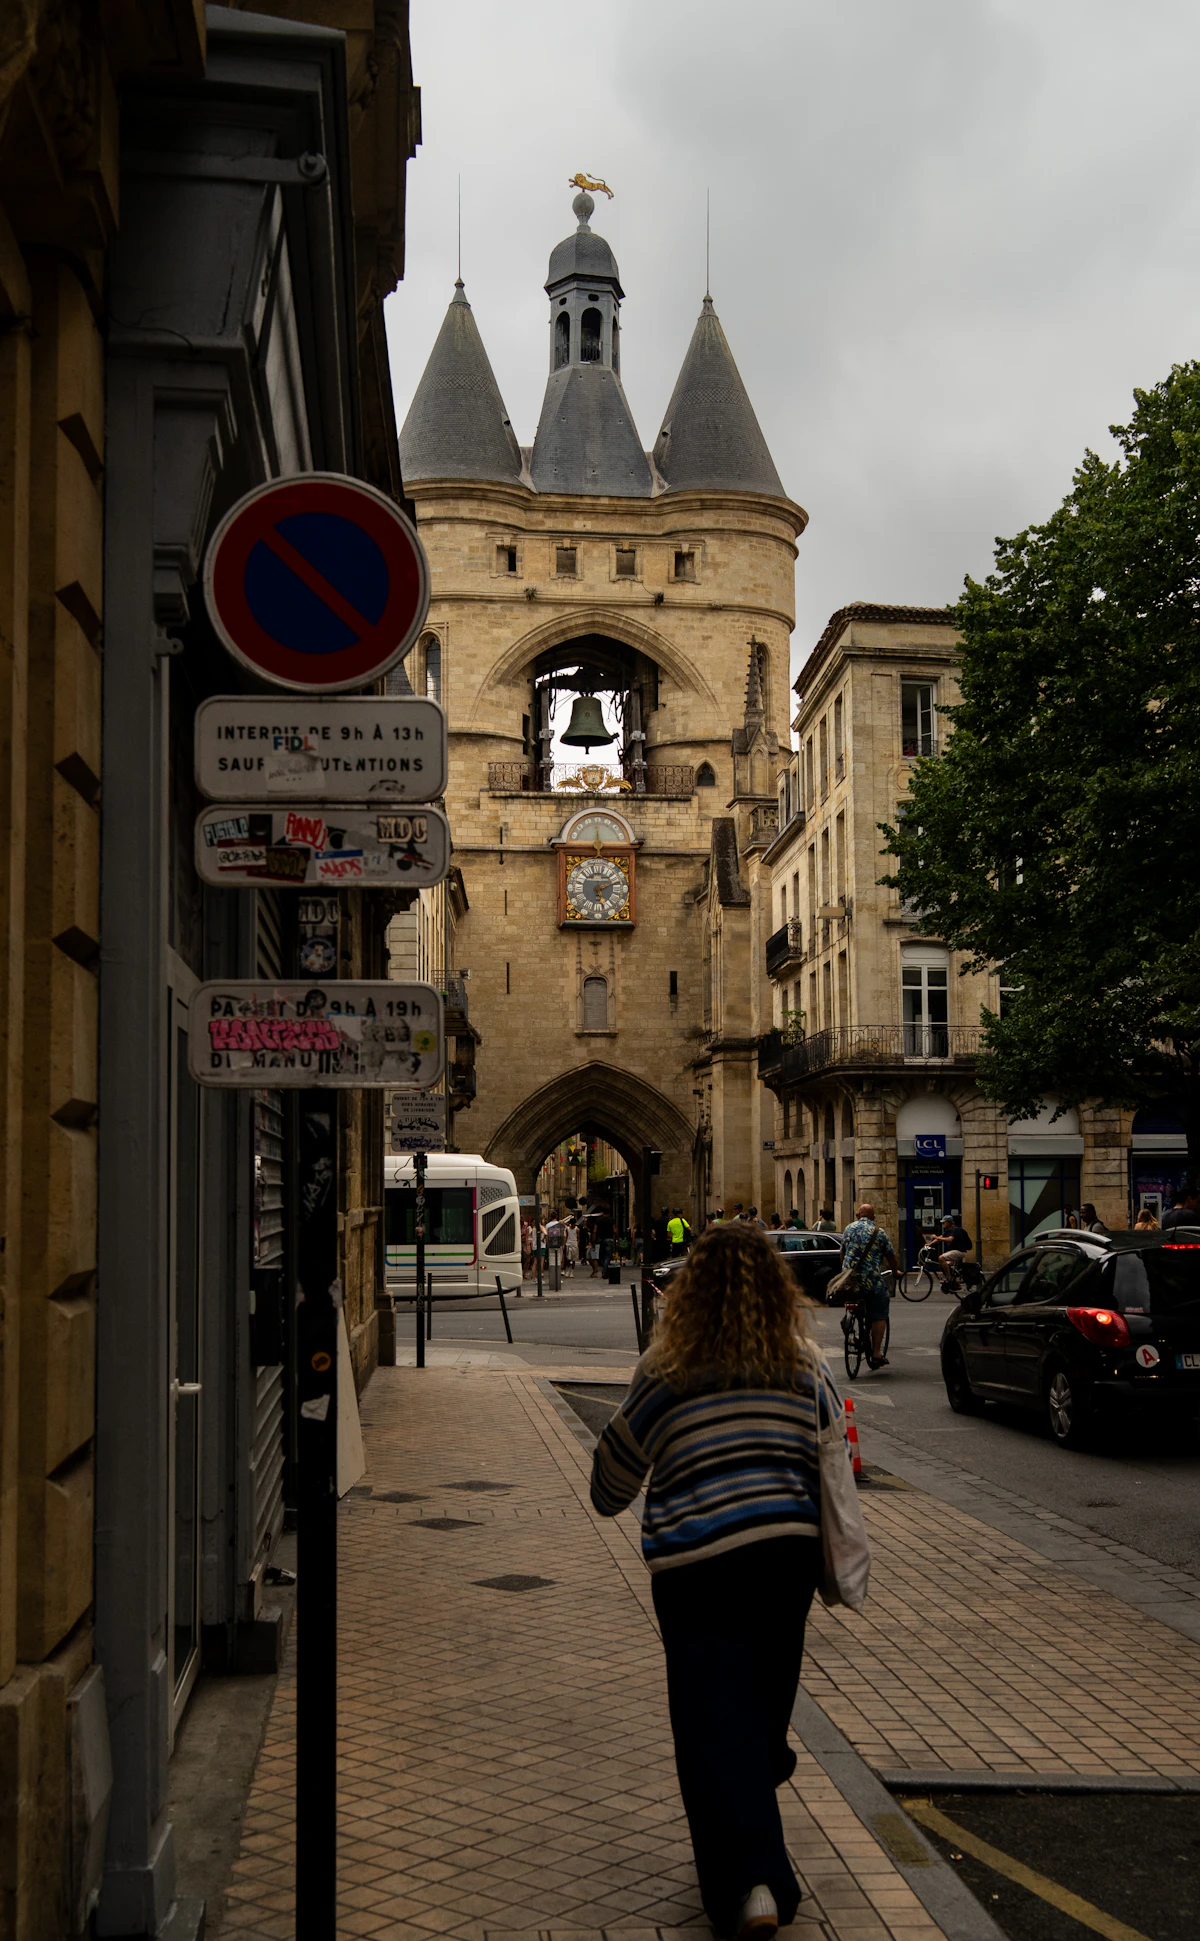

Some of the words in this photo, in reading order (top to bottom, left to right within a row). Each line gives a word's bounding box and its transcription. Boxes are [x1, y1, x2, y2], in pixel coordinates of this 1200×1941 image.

[341, 727, 364, 740] 9h
[373, 723, 383, 740] À
[393, 727, 424, 740] 13h
[211, 1000, 286, 1017] PAT
[330, 1000, 355, 1015] 9h
[386, 1001, 421, 1017] 19h
[917, 1139, 942, 1149] LCL
